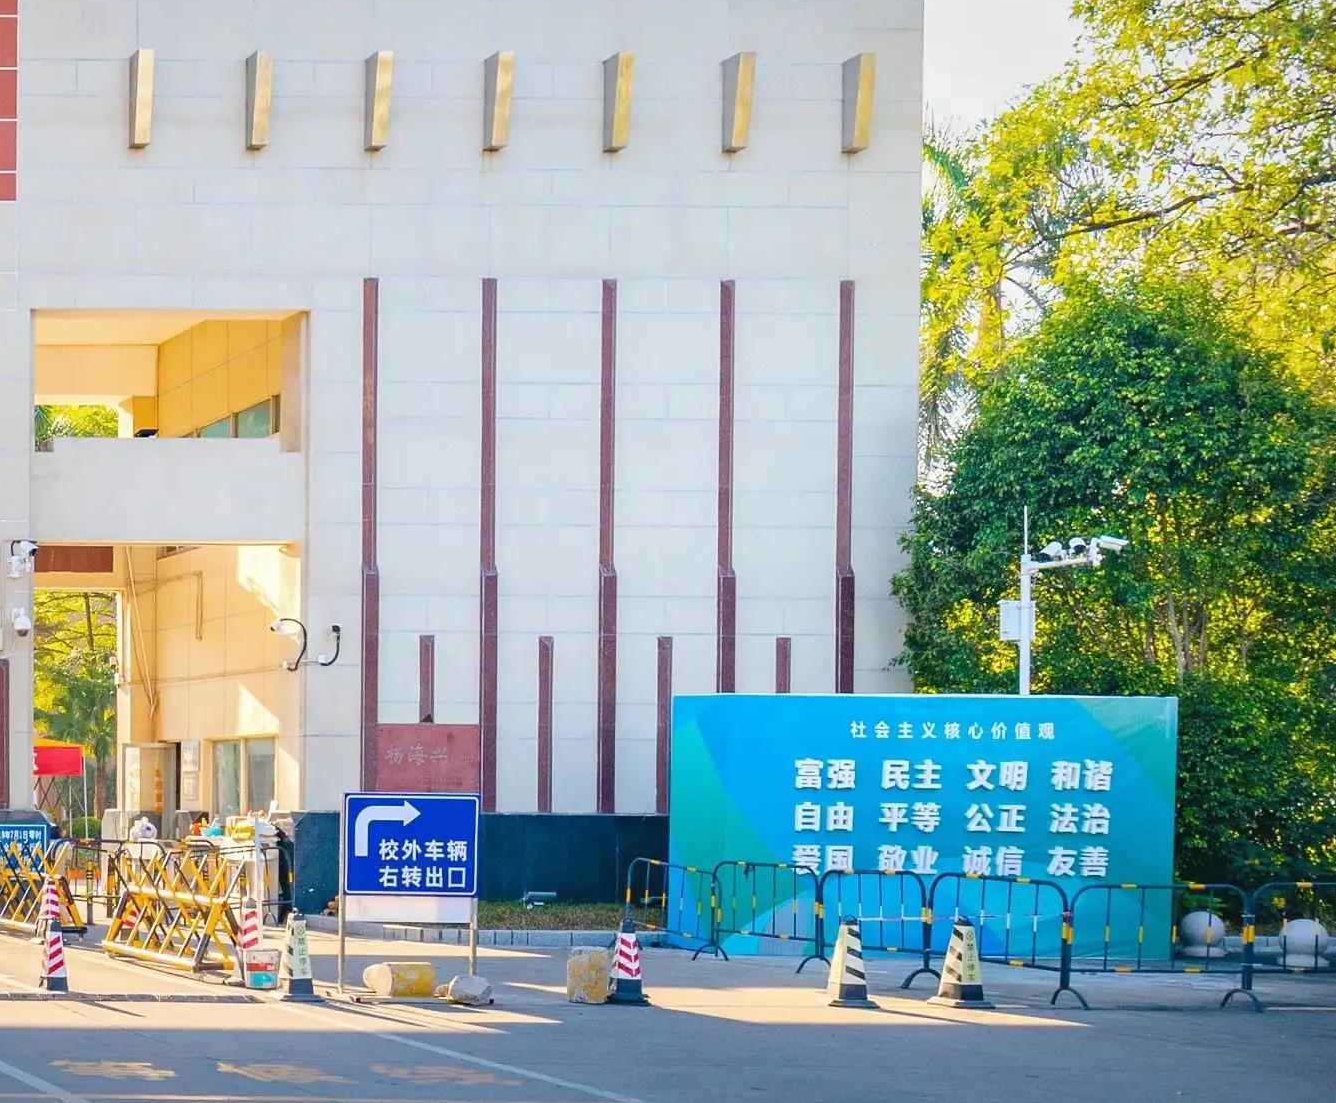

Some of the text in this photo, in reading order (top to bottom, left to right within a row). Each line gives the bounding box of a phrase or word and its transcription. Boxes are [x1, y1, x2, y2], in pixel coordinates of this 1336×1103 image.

[850, 720, 1057, 740] 社会主义核心价值观
[794, 758, 1113, 791] 富强 民主 文明 和谐
[794, 802, 1111, 835] 自由 平等 公正 法治
[379, 838, 468, 862] 校外车辆
[791, 845, 1109, 878] 爱国 敬业 诚信 友善
[379, 865, 466, 889] 右转出口
